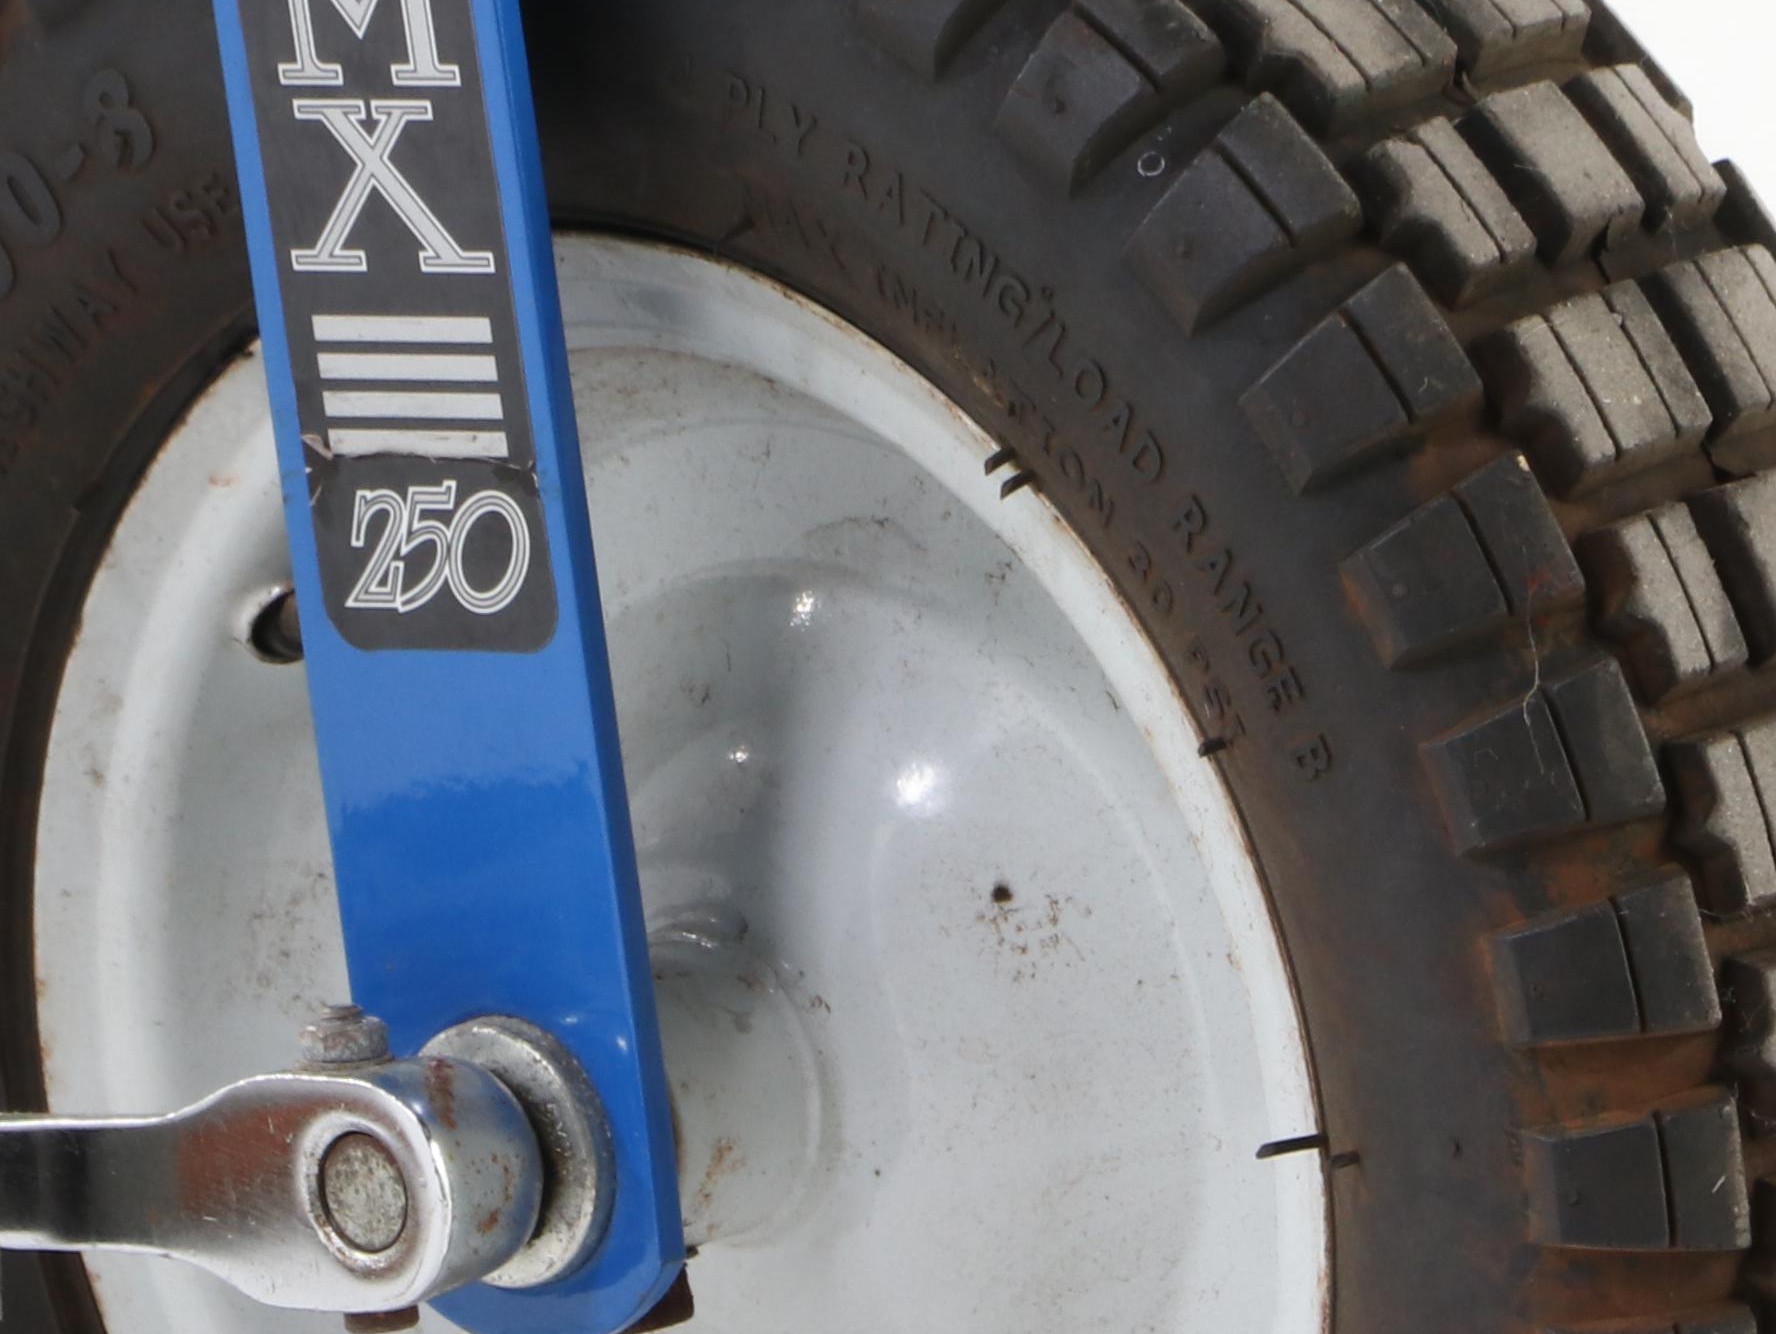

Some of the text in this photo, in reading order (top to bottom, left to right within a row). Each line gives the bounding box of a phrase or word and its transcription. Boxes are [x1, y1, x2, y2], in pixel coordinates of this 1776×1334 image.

[345, 480, 531, 615] 250
[723, 69, 820, 158] PLY
[1170, 491, 1308, 717] RANGE
